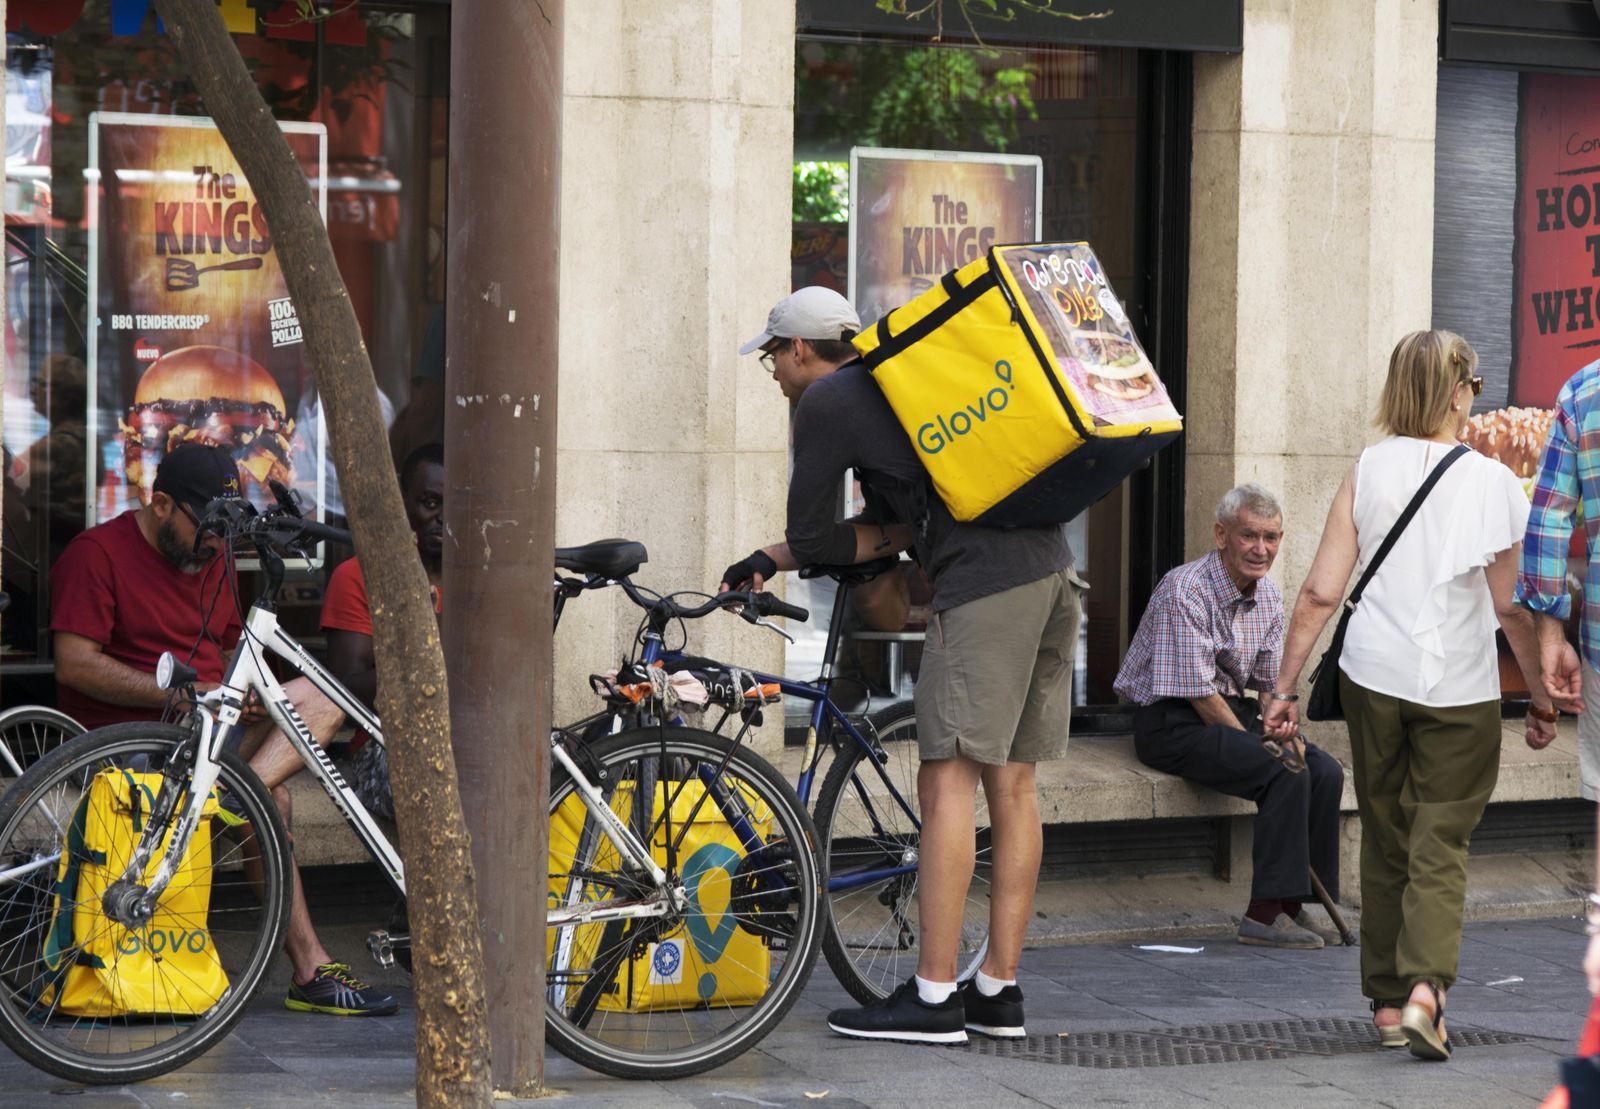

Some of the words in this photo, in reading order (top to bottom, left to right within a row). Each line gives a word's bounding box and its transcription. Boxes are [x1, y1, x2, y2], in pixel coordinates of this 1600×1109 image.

[193, 166, 236, 199] The
[932, 194, 968, 225] The
[155, 201, 272, 255] KINGS
[112, 315, 133, 330] BBQ
[1532, 286, 1600, 335] WH
[272, 326, 303, 344] POLLO
[137, 349, 160, 359] NUEVO
